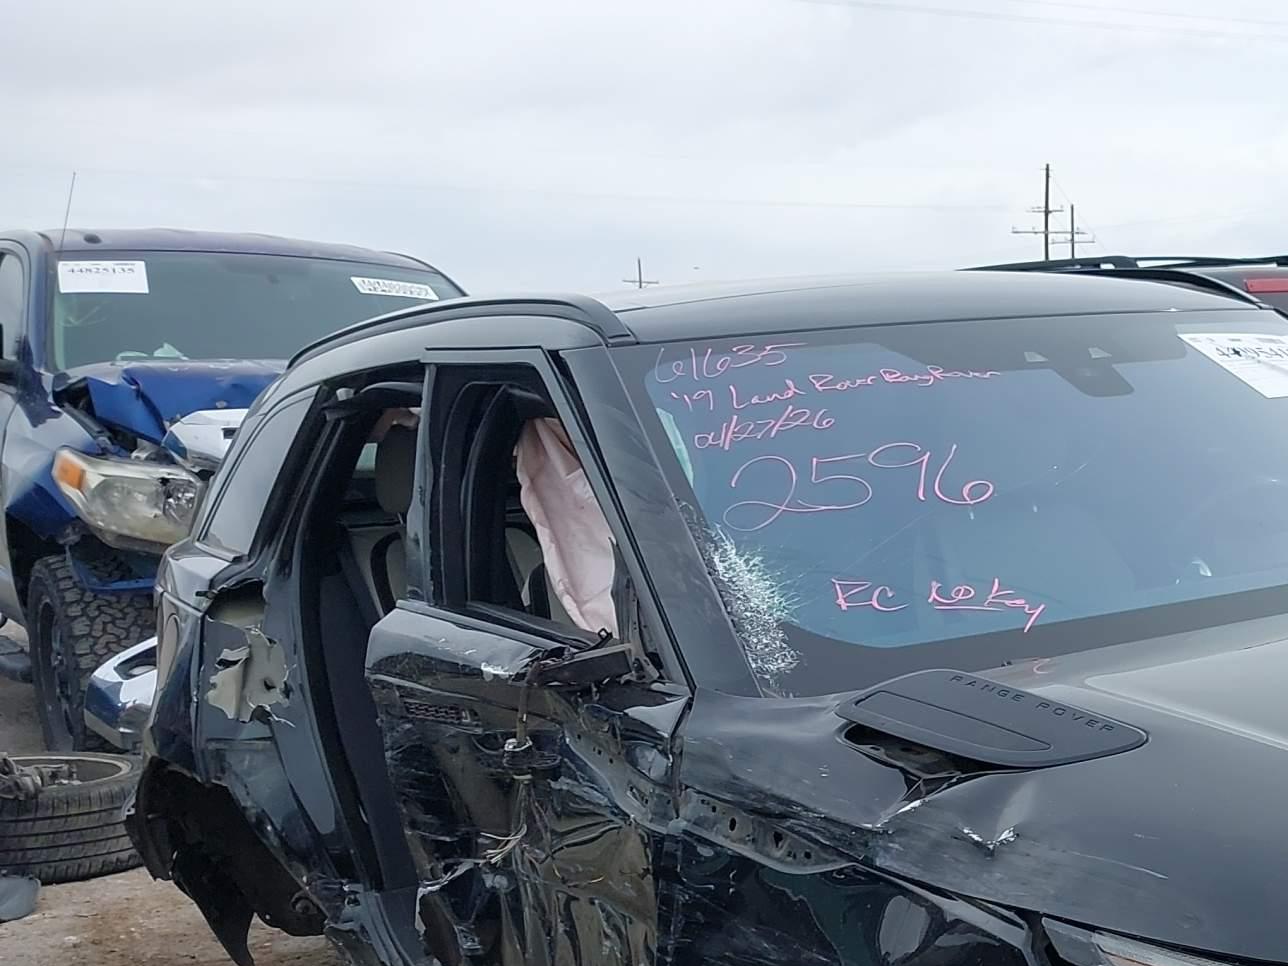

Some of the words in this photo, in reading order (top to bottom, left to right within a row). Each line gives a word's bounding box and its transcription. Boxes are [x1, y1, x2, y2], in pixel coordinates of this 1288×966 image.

[654, 342, 807, 383] 61635
[730, 379, 807, 409] Land
[722, 442, 994, 531] 2596
[949, 674, 1025, 702] RANGE
[1036, 701, 1115, 733] ROVER
